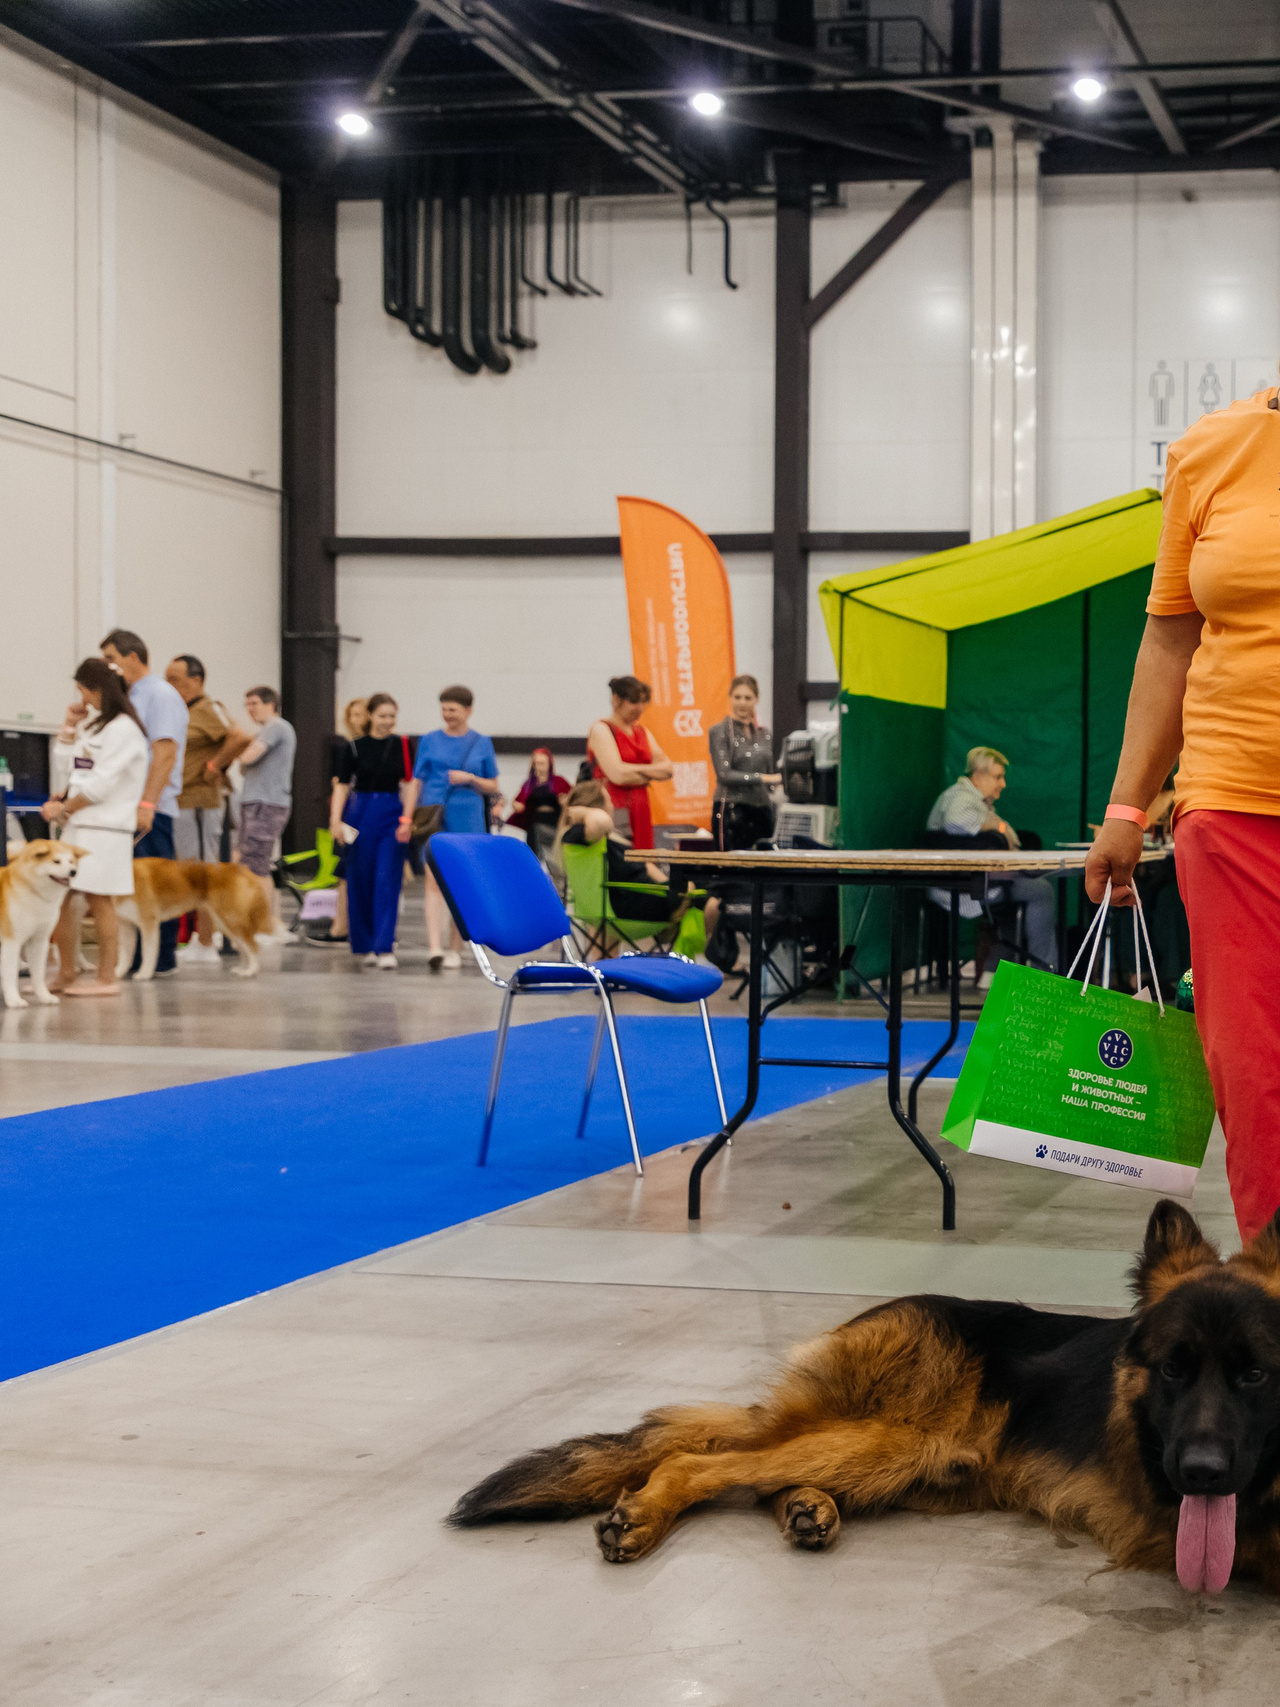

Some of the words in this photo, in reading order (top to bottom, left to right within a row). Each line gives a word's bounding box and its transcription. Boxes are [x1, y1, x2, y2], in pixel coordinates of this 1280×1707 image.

[1067, 1068, 1114, 1087] ЗДОРОВЬЕ
[1115, 1079, 1148, 1095] ЛЮДЕЙ
[1071, 1082, 1079, 1092] И
[1081, 1085, 1134, 1105] ЖИВОТНЫХ
[1061, 1094, 1088, 1108] НАША
[1091, 1101, 1147, 1121] ПРОФЕССИЯ
[1050, 1149, 1080, 1165] ПОДАРИ
[1080, 1156, 1105, 1169] ДРУГУ
[1104, 1161, 1143, 1178] ЗДОРОВЬЕ
